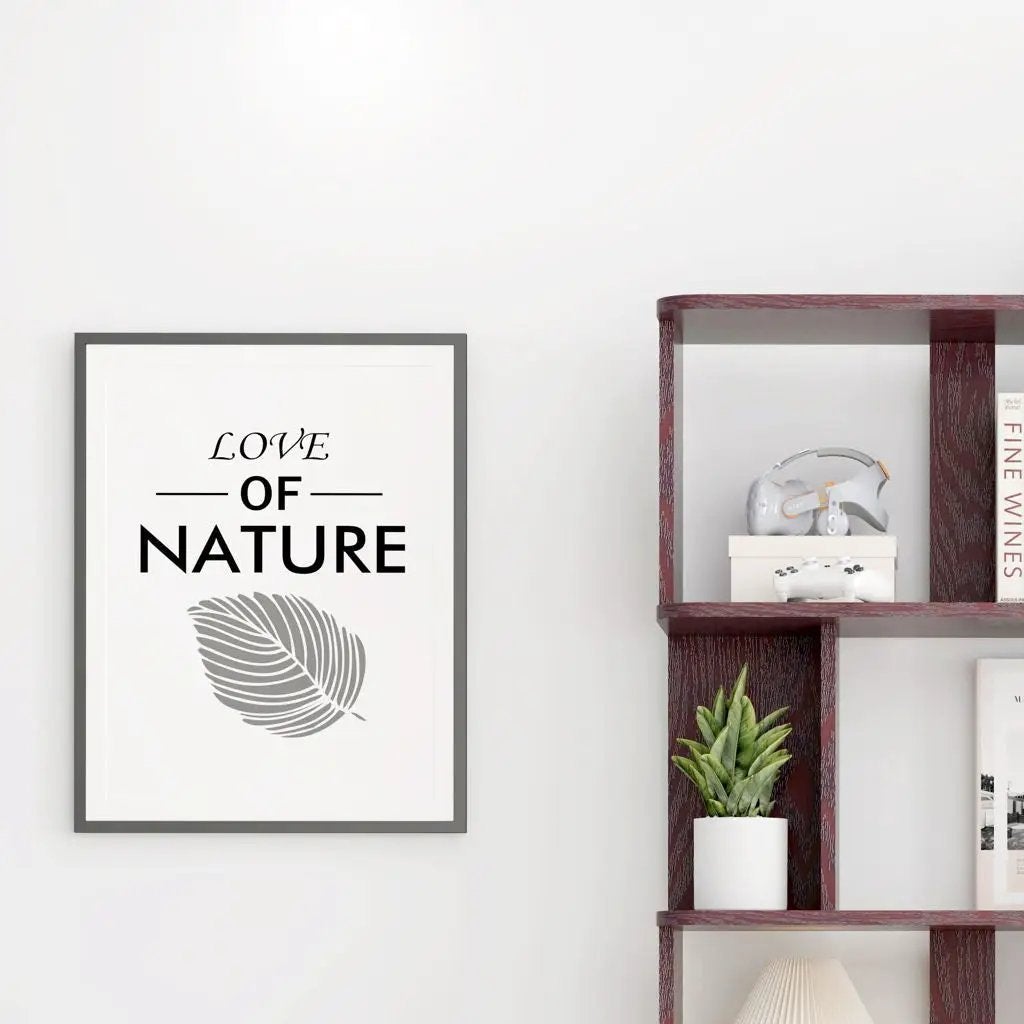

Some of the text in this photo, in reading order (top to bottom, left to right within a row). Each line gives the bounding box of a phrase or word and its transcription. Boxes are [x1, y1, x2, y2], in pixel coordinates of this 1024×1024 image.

[209, 428, 330, 461] LOVE
[1003, 423, 1022, 479] FINE
[240, 475, 302, 511] OF
[140, 524, 406, 575] NATURE
[1003, 492, 1022, 578] WINES
